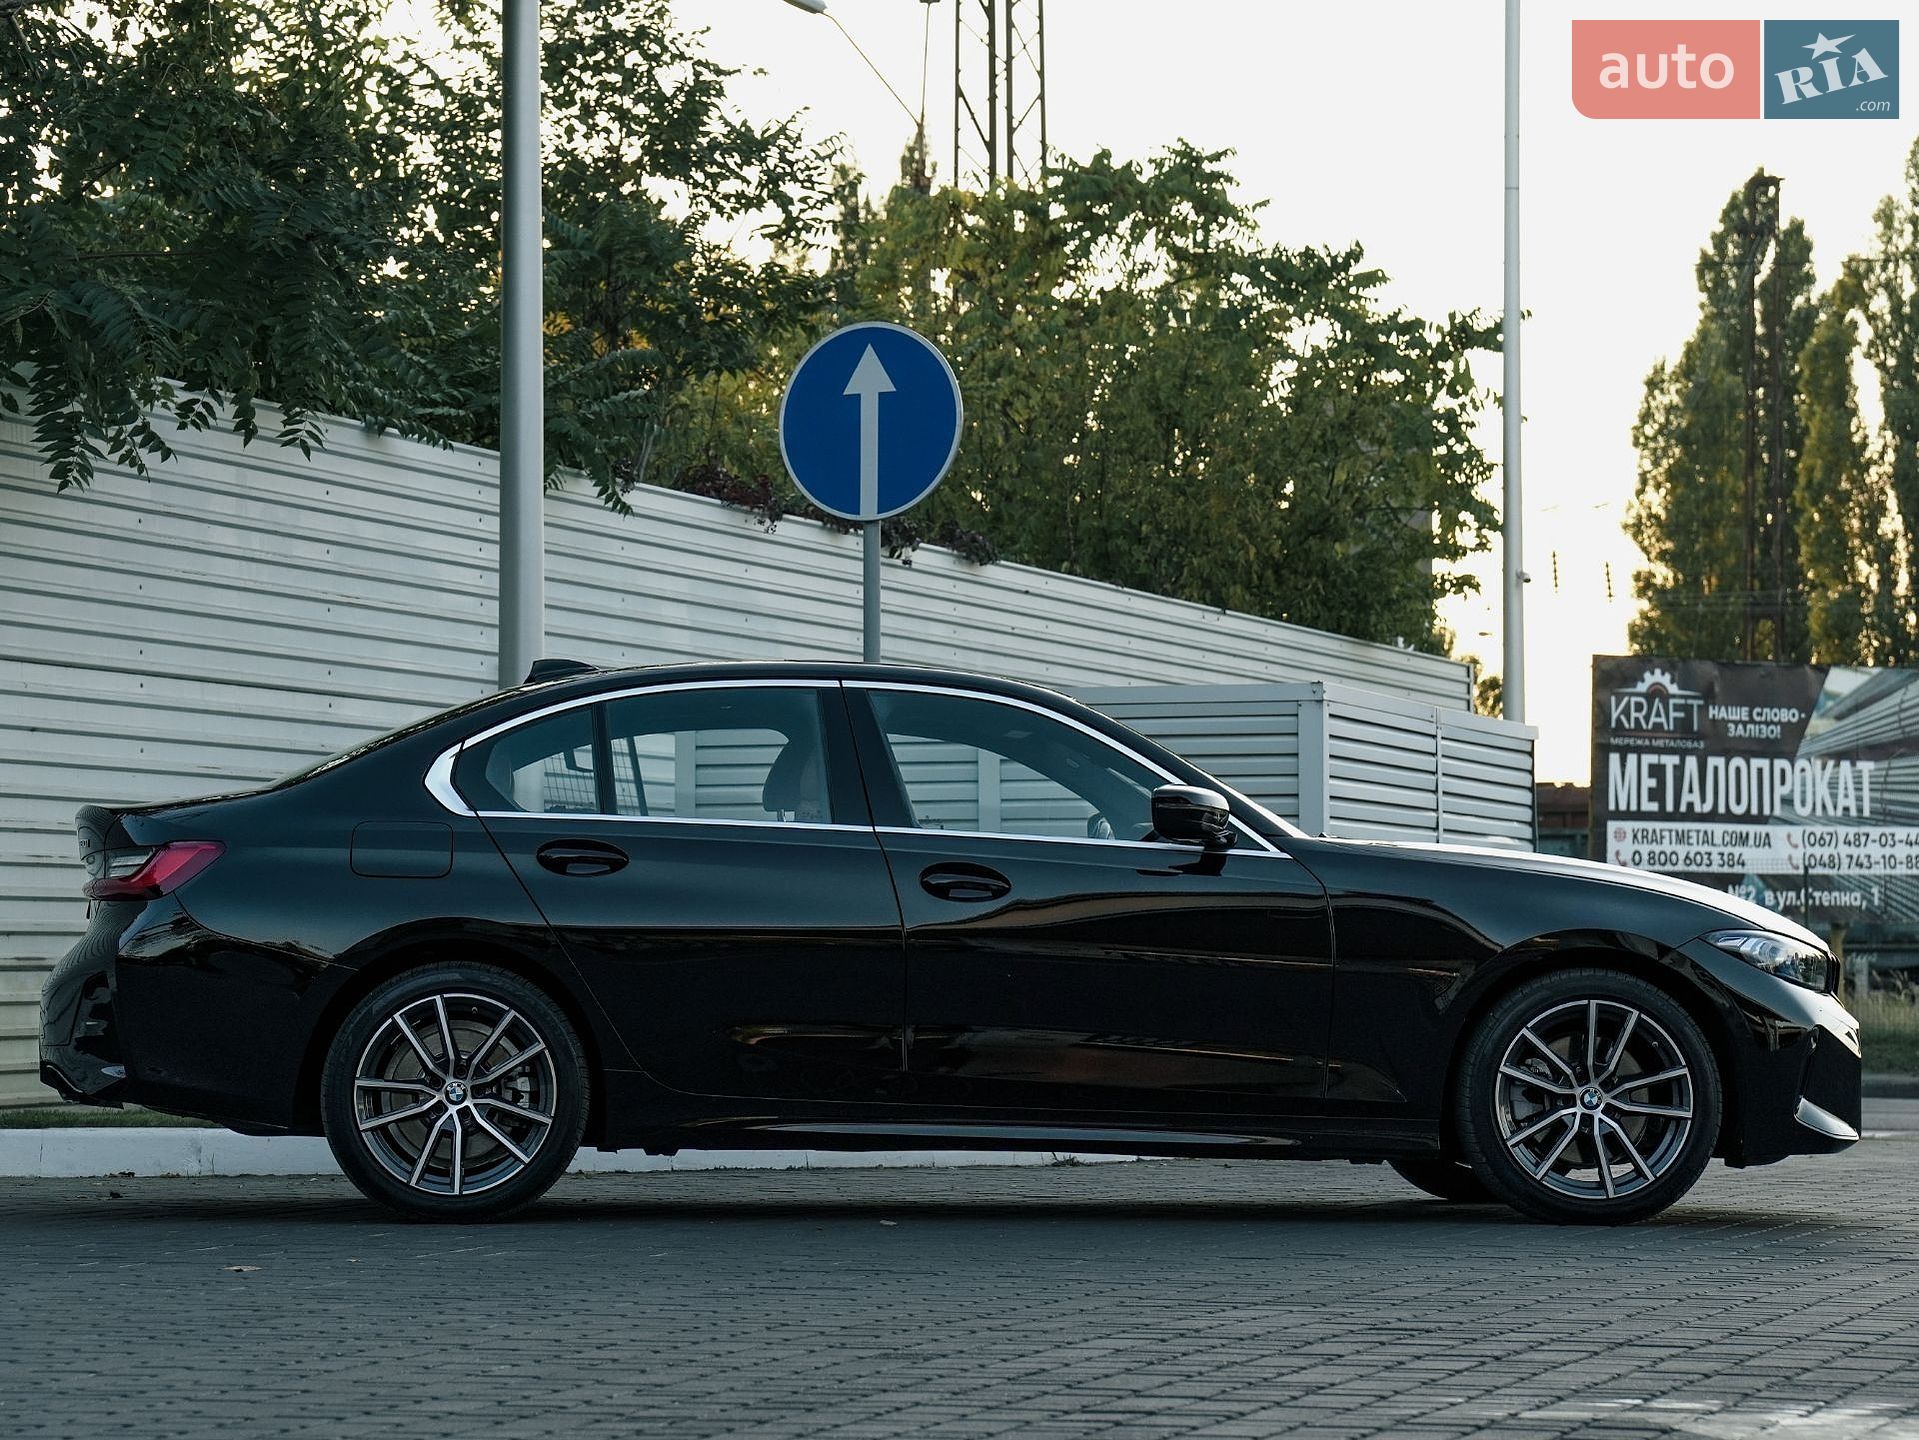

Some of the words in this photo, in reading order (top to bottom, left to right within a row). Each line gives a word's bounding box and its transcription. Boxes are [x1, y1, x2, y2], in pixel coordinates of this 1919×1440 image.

[1610, 695, 1704, 732] KRAFT
[1708, 704, 1750, 721] НАШЕ
[1727, 723, 1781, 739] ЗАЛІЗО!
[1608, 752, 1875, 817] МЕТАЛОПРОКАТ
[1631, 828, 1772, 848] KRAFTMETAL.COM.UA
[1802, 829, 1839, 849] (067)
[1631, 850, 1642, 867] 0
[1647, 850, 1679, 867] 800
[1683, 851, 1713, 868] 603
[1717, 852, 1746, 869] 384
[1802, 851, 1841, 871] (048)
